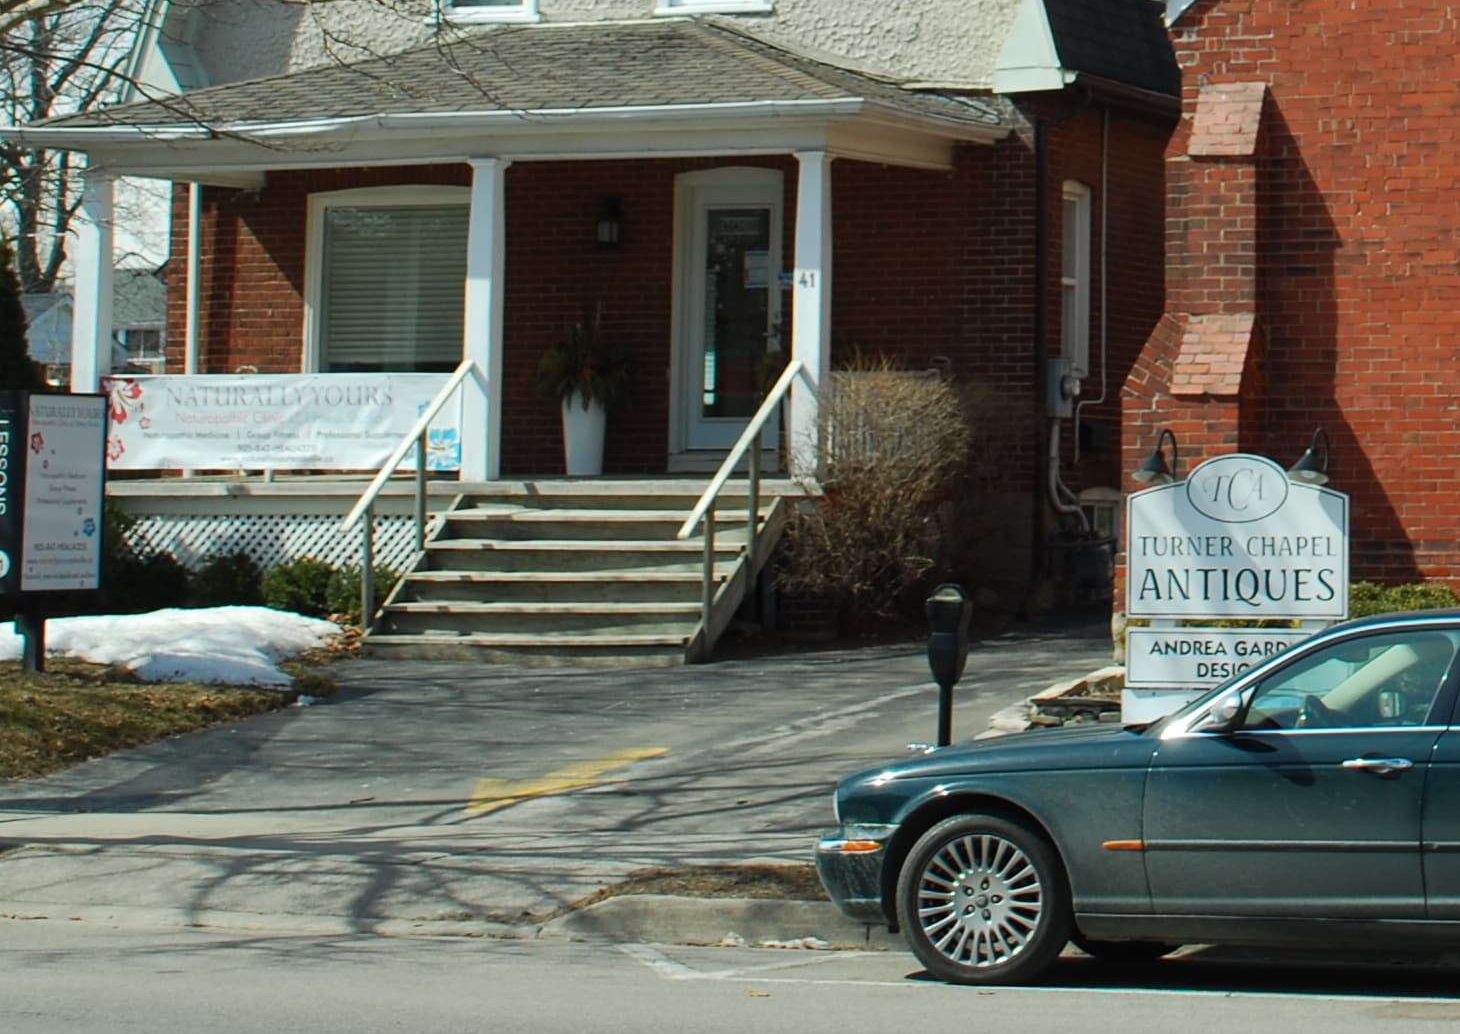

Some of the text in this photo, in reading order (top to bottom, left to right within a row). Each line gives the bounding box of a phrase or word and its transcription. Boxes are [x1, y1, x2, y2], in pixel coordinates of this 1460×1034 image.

[799, 272, 815, 288] 41
[166, 385, 393, 407] NATURALLY YOURS
[1138, 535, 1337, 557] TURNER CHAPEL
[1139, 568, 1335, 607] ANTIQUES
[1150, 640, 1292, 657] ANDREA GARD
